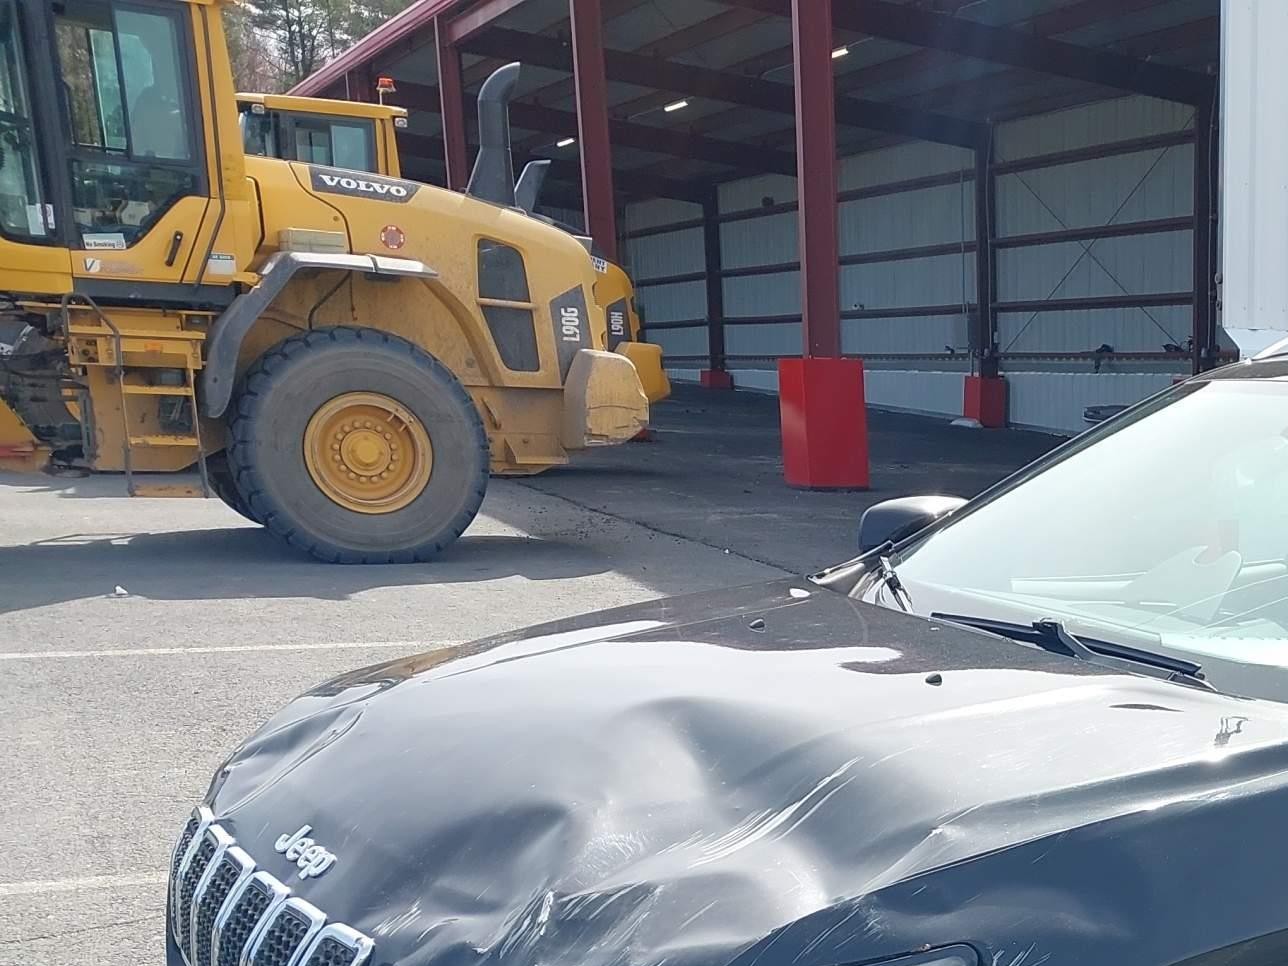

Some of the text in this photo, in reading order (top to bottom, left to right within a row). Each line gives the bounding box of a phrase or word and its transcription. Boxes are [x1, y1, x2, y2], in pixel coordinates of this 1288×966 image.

[319, 174, 407, 197] VOLVO
[560, 306, 580, 342] L90G
[610, 311, 624, 336] L90H
[274, 824, 338, 880] Jeep
